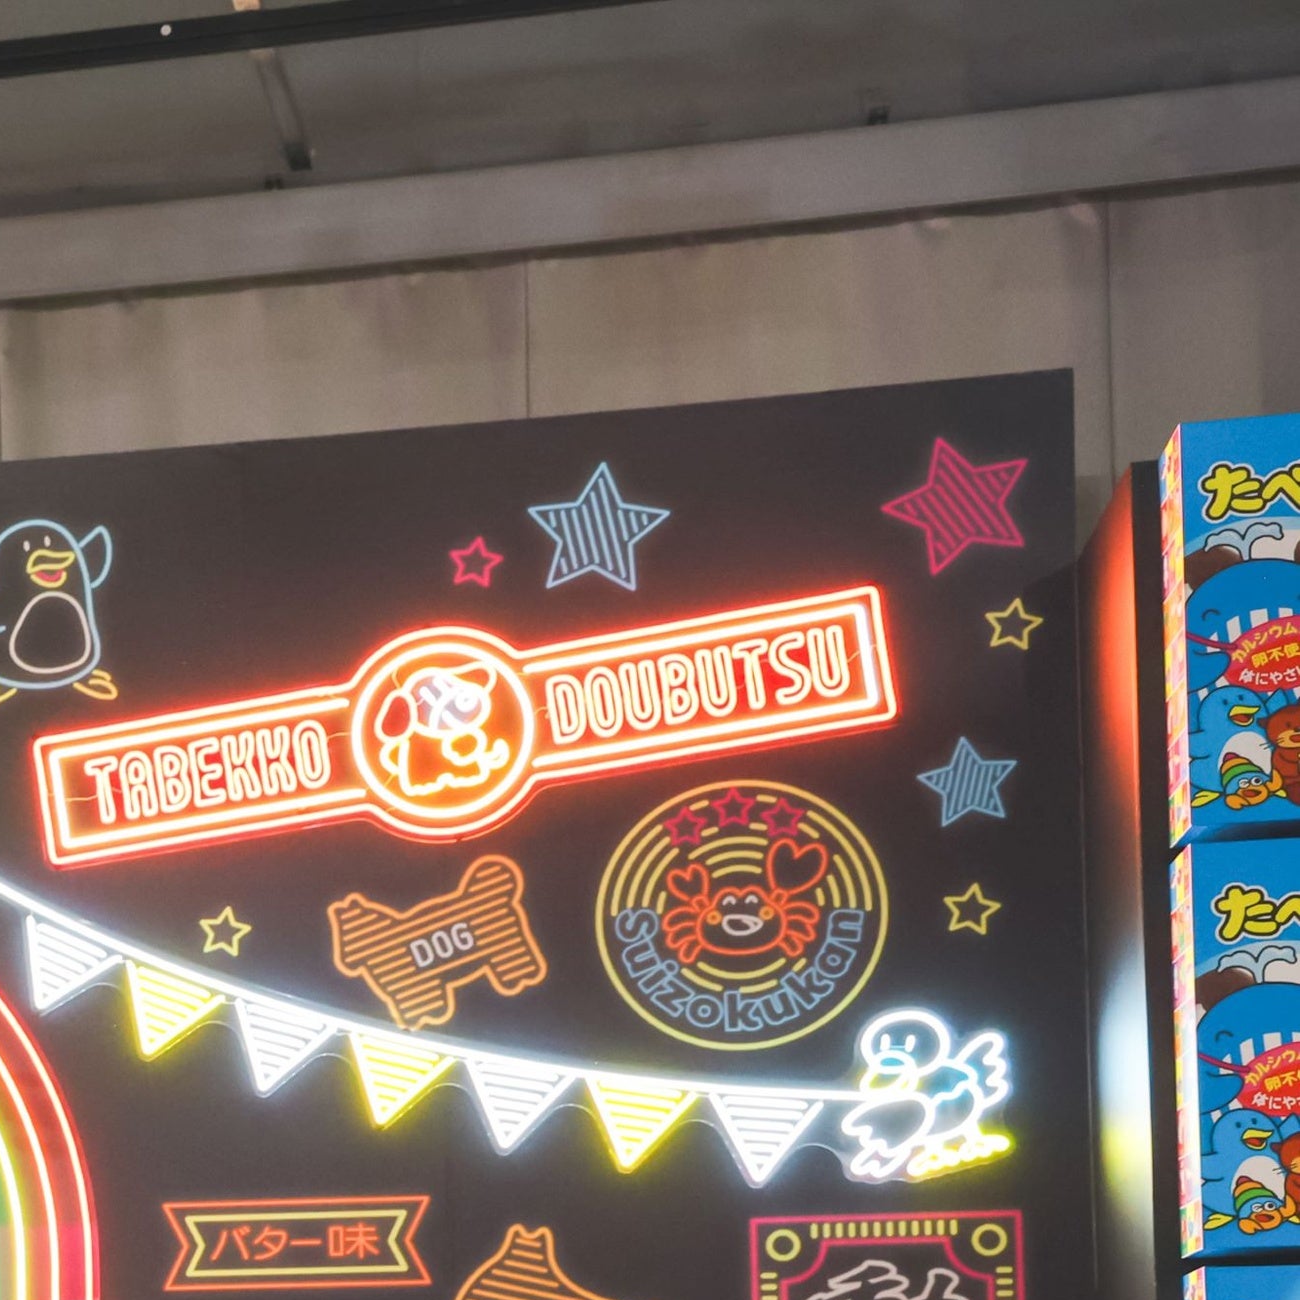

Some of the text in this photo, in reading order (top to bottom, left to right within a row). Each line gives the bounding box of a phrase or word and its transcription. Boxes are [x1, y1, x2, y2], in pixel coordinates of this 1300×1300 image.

[83, 624, 850, 824] TABEKKO DOUBUTSU
[408, 922, 475, 969] DOG
[613, 907, 865, 1032] Suizokukan
[1245, 1050, 1300, 1087] カルシウ
[209, 1222, 381, 1261] バター味
